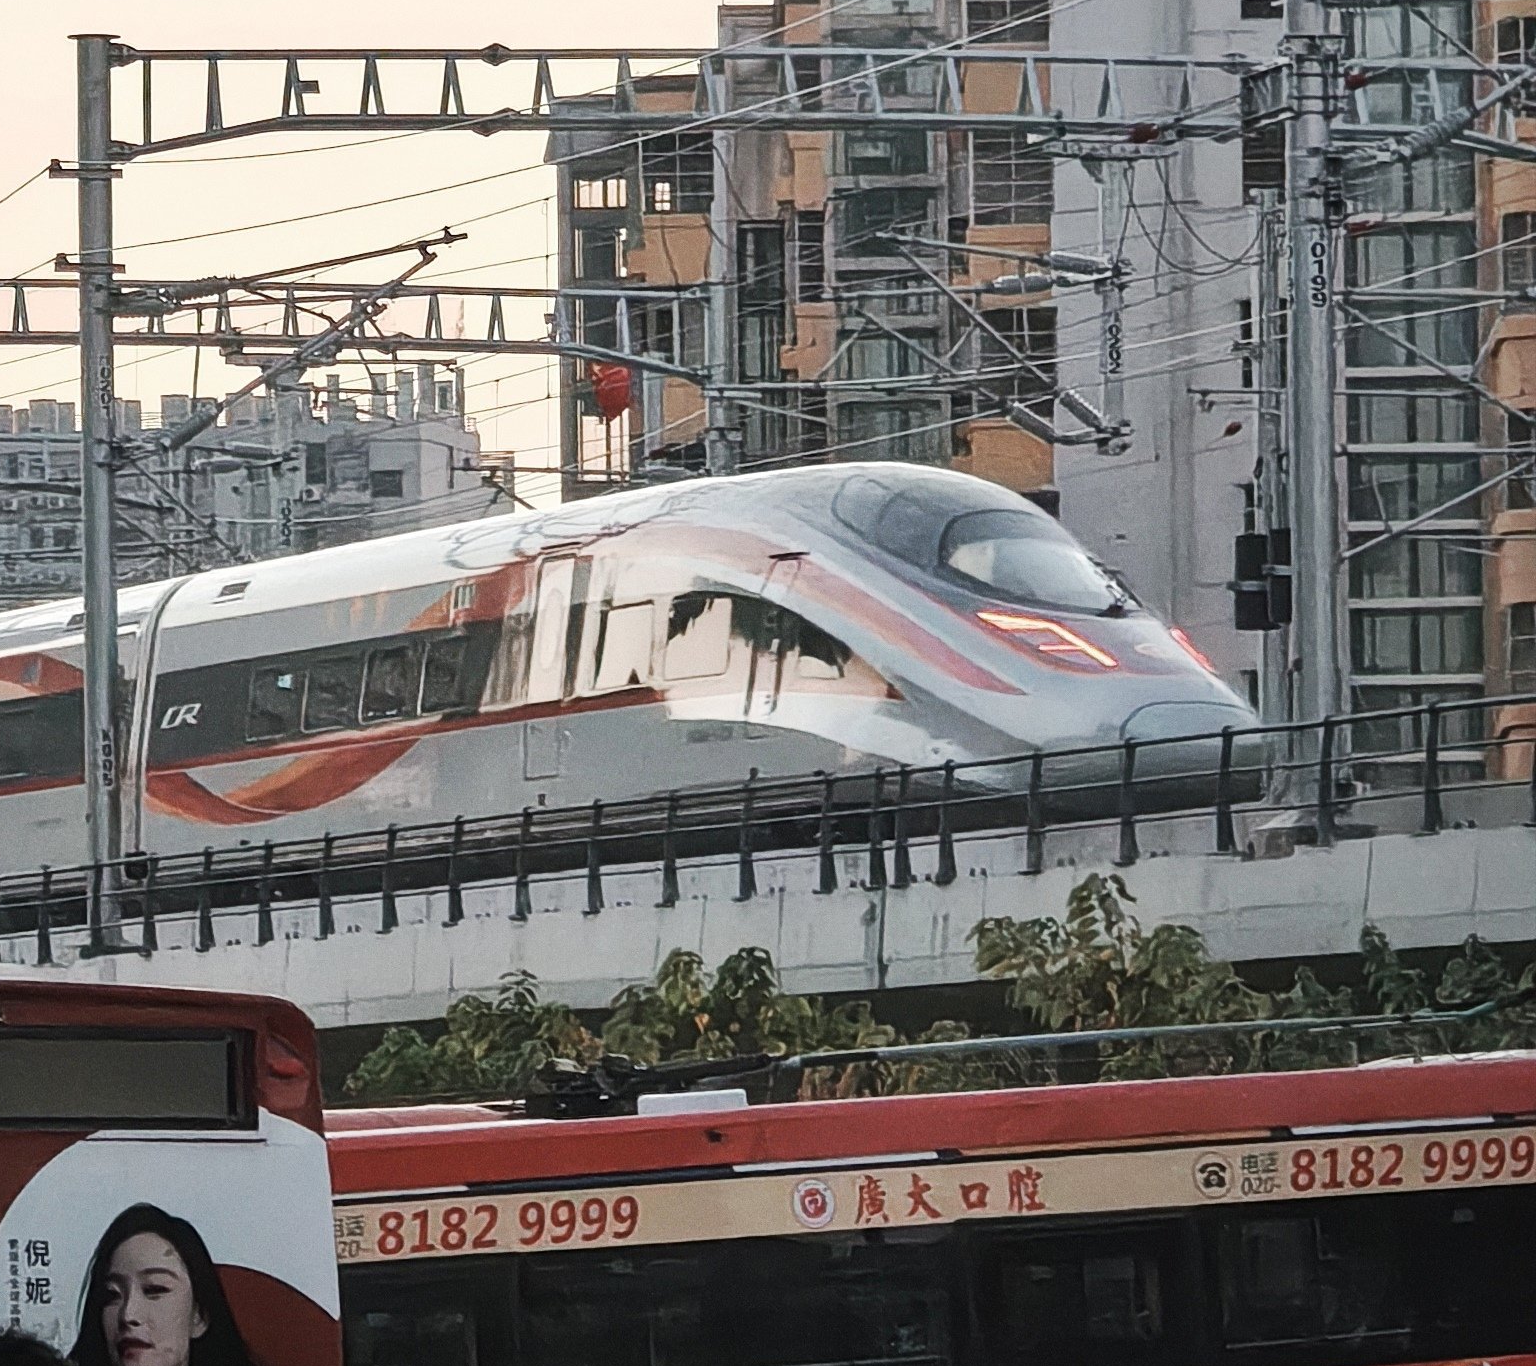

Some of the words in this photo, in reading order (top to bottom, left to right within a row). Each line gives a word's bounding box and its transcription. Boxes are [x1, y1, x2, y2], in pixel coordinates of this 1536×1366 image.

[160, 702, 202, 729] CR
[1290, 1143, 1404, 1192] 8182
[1423, 1134, 1535, 1183] 9999
[376, 1204, 500, 1256] 8182
[518, 1195, 640, 1247] 9999
[854, 1165, 1047, 1226] 廣大口腔
[24, 1239, 53, 1305] 倪妮
